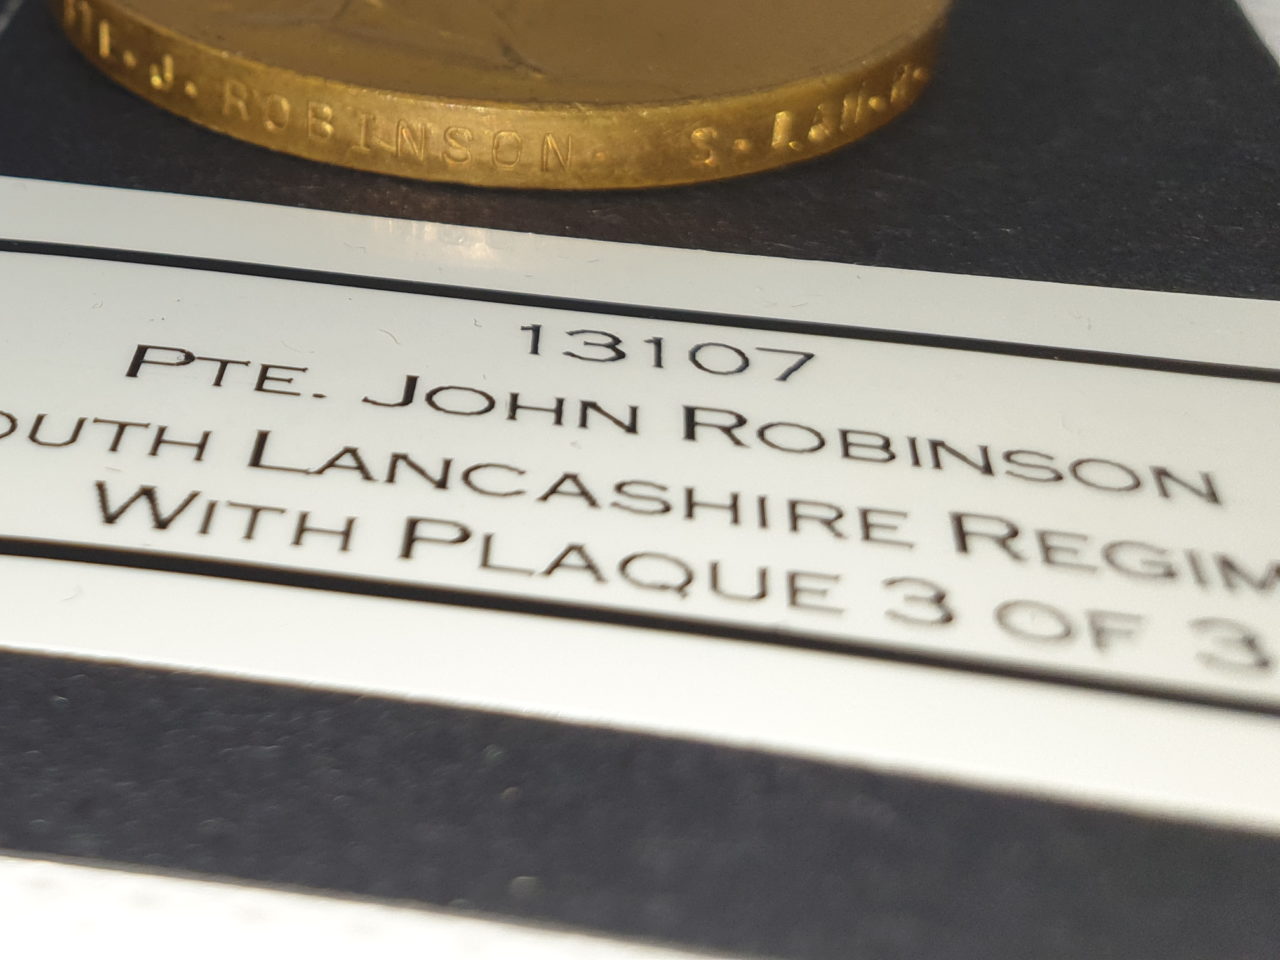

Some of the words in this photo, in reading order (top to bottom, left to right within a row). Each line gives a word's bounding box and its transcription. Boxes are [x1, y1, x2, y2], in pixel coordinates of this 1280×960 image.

[520, 324, 815, 382] 13107
[248, 430, 913, 546] LANCASHIRE
[362, 375, 639, 435] JOHN
[683, 405, 1222, 505] ROBINSON
[94, 480, 356, 552] WITH
[398, 516, 842, 613] PLAQUE
[883, 577, 957, 627] 3
[993, 599, 1144, 653] OF
[1190, 617, 1277, 675] 3
